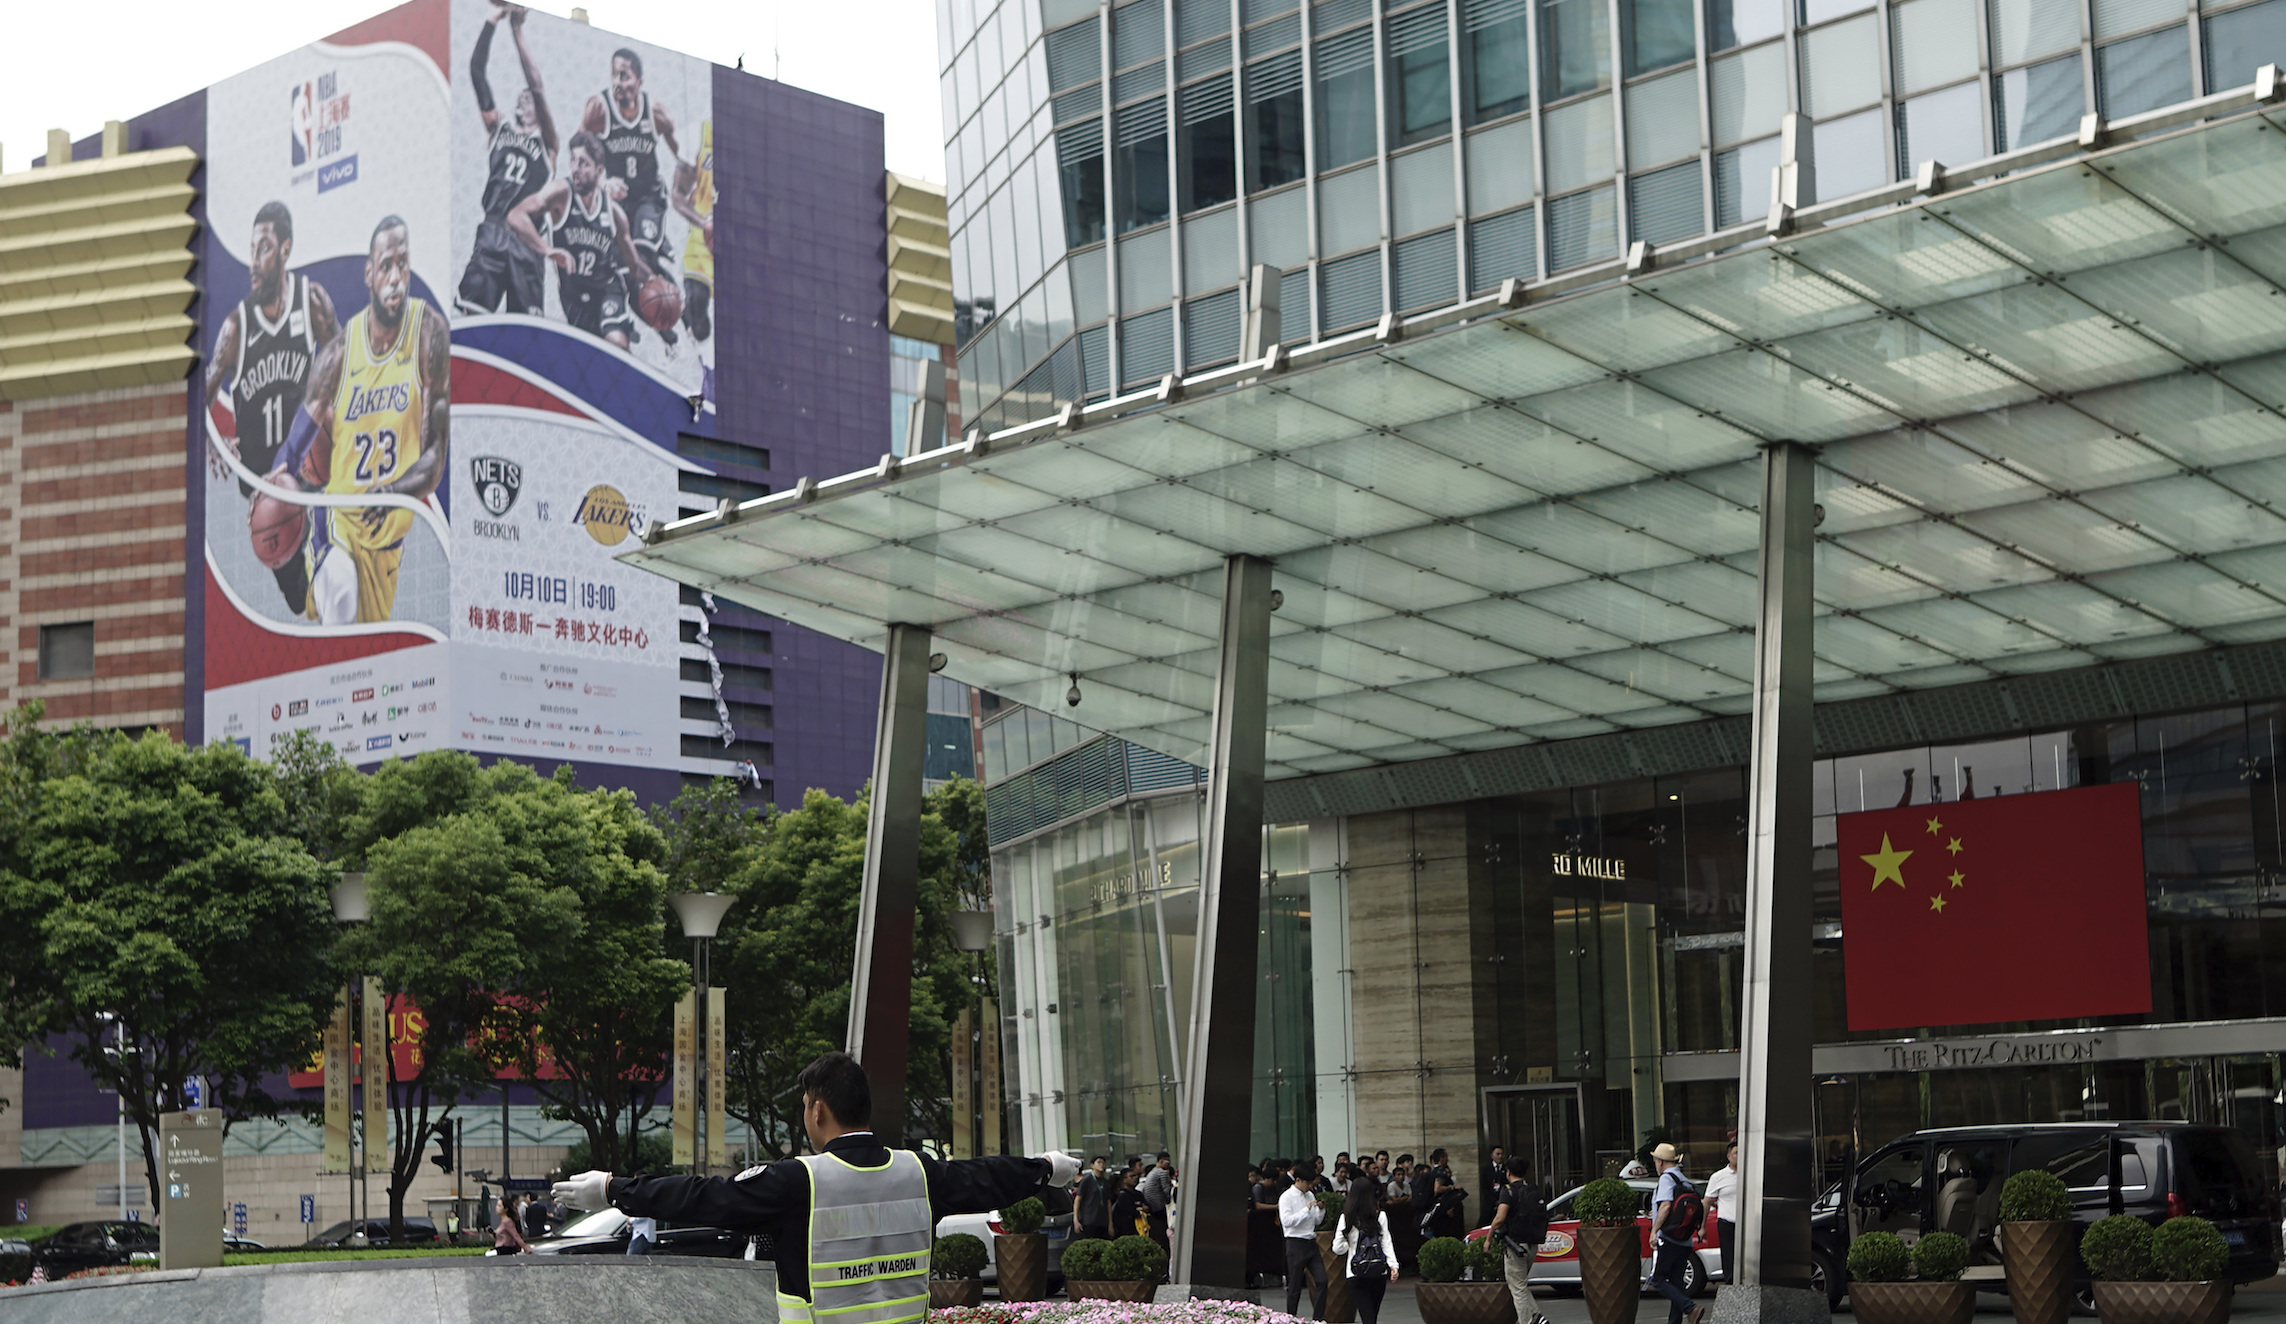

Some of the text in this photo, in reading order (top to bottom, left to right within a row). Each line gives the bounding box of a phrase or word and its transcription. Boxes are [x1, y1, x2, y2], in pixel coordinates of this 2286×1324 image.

[317, 70, 337, 101] NBA
[317, 125, 341, 159] 2019
[497, 132, 541, 161] BROOKLYN
[606, 136, 655, 154] BROOKLYN
[321, 163, 354, 184] vivo
[505, 153, 527, 185] 22
[626, 156, 637, 178] 8
[564, 227, 611, 253] BROOKLYN
[578, 251, 596, 276] 12
[239, 350, 308, 402] BROOKLYN
[344, 382, 410, 422] LAKERS
[262, 394, 283, 448] 11
[353, 428, 398, 487] 23
[474, 458, 520, 490] NETS
[537, 500, 552, 522] VS.
[572, 496, 646, 538] LAKERS
[474, 519, 520, 542] BROOKLYN
[504, 571, 615, 611] 10月10日 19:00
[1577, 855, 1625, 880] MILLE
[1090, 873, 1135, 903] RICHARD
[1885, 1047, 1928, 1069] THE
[170, 1184, 180, 1198] P
[838, 1258, 916, 1279] TRAFFIC WARDEN
